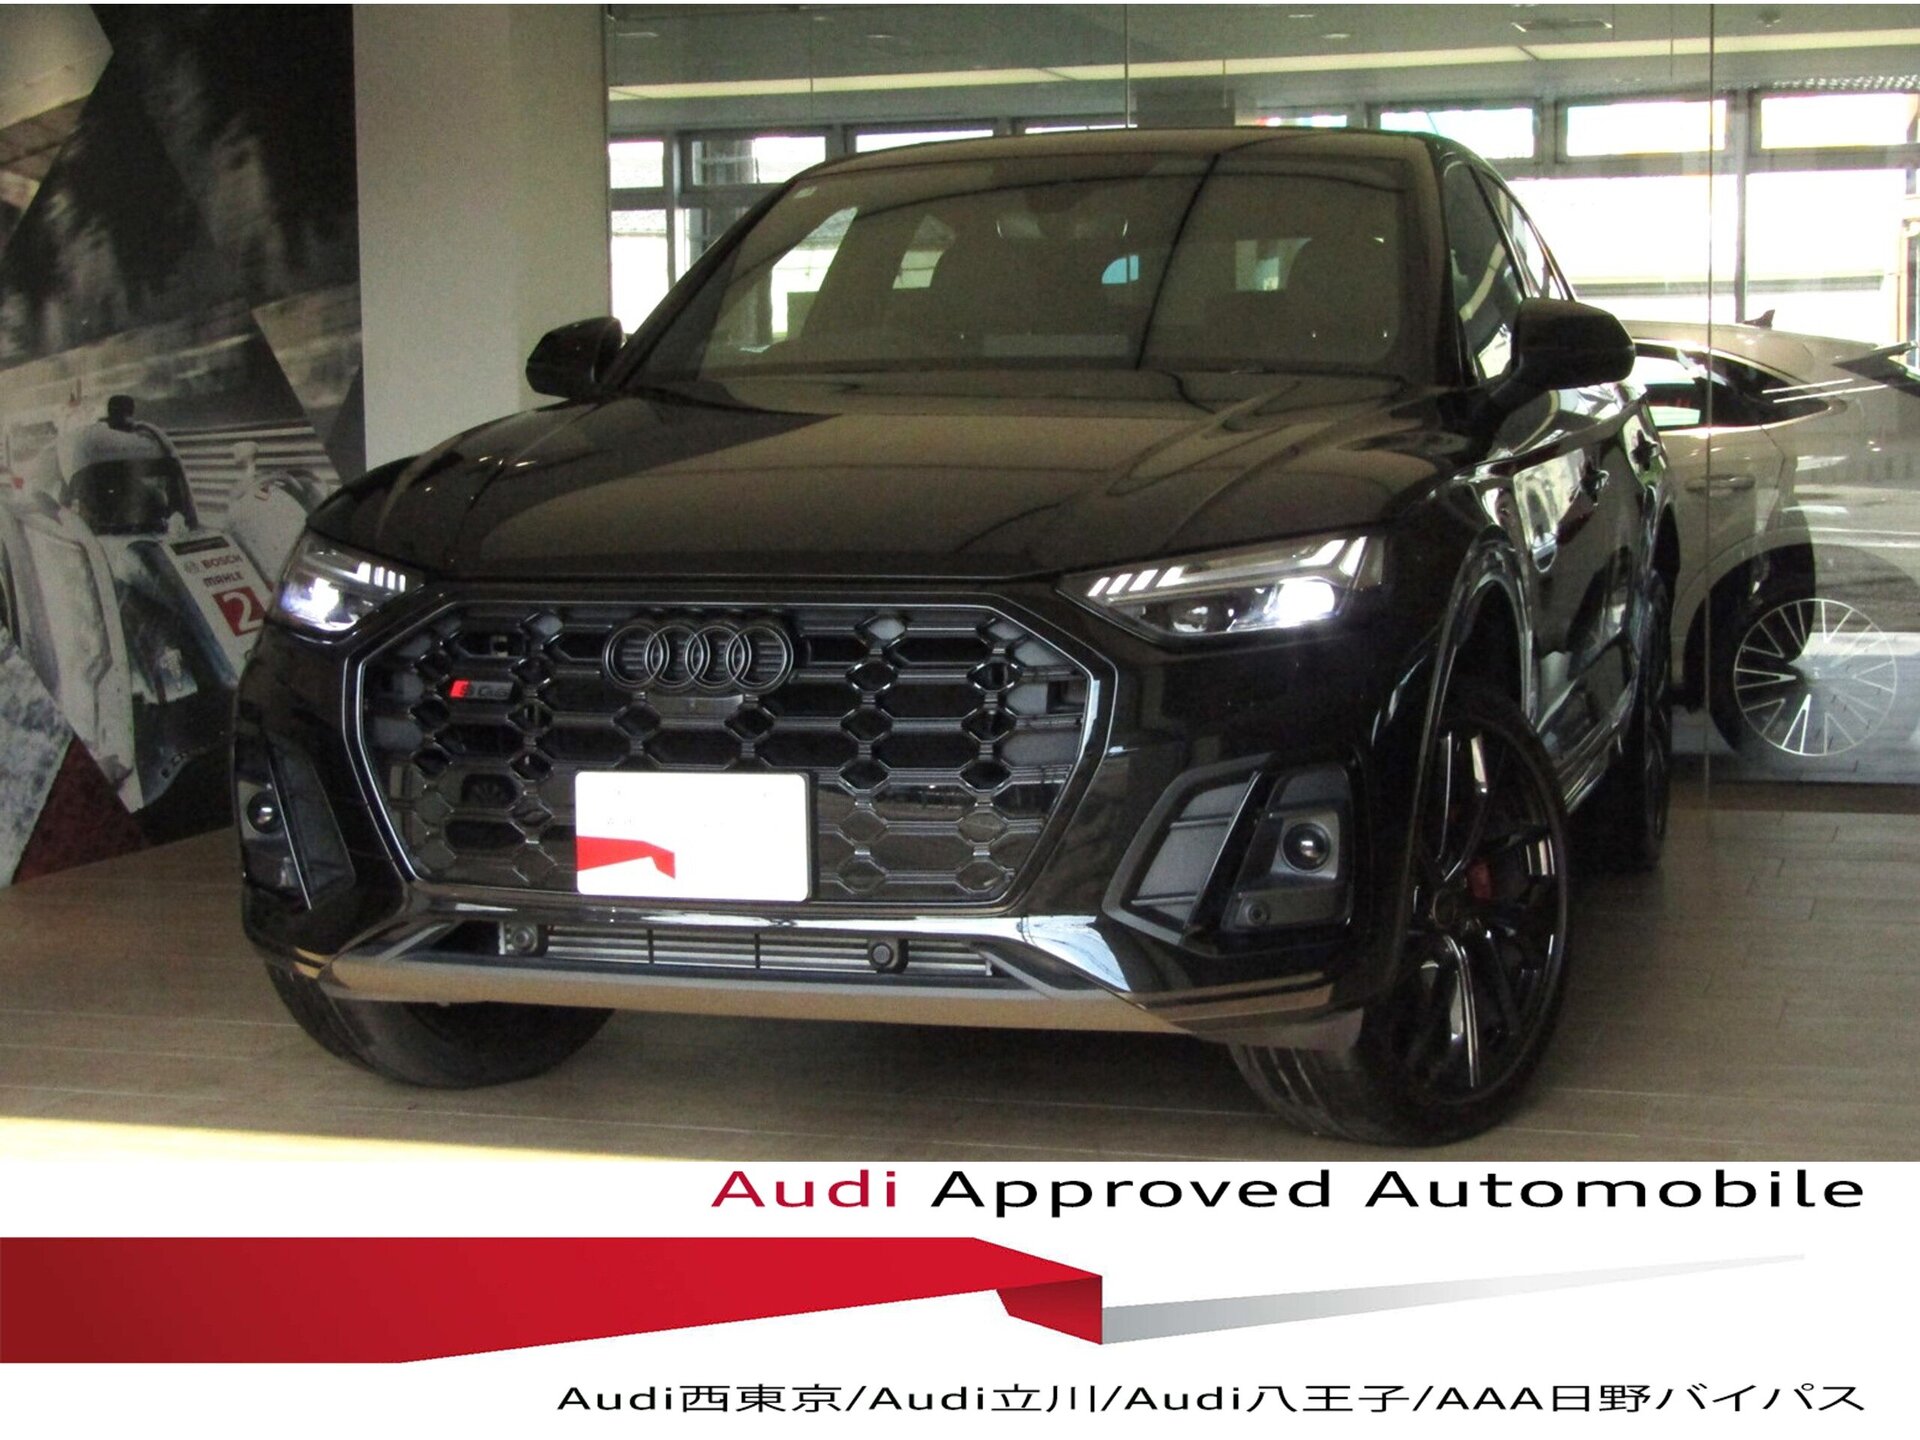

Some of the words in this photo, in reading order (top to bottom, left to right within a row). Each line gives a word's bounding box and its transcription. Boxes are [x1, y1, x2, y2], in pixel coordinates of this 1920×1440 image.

[202, 555, 243, 569] BOSCH
[203, 571, 245, 588] MAHLE
[223, 592, 263, 631] 2
